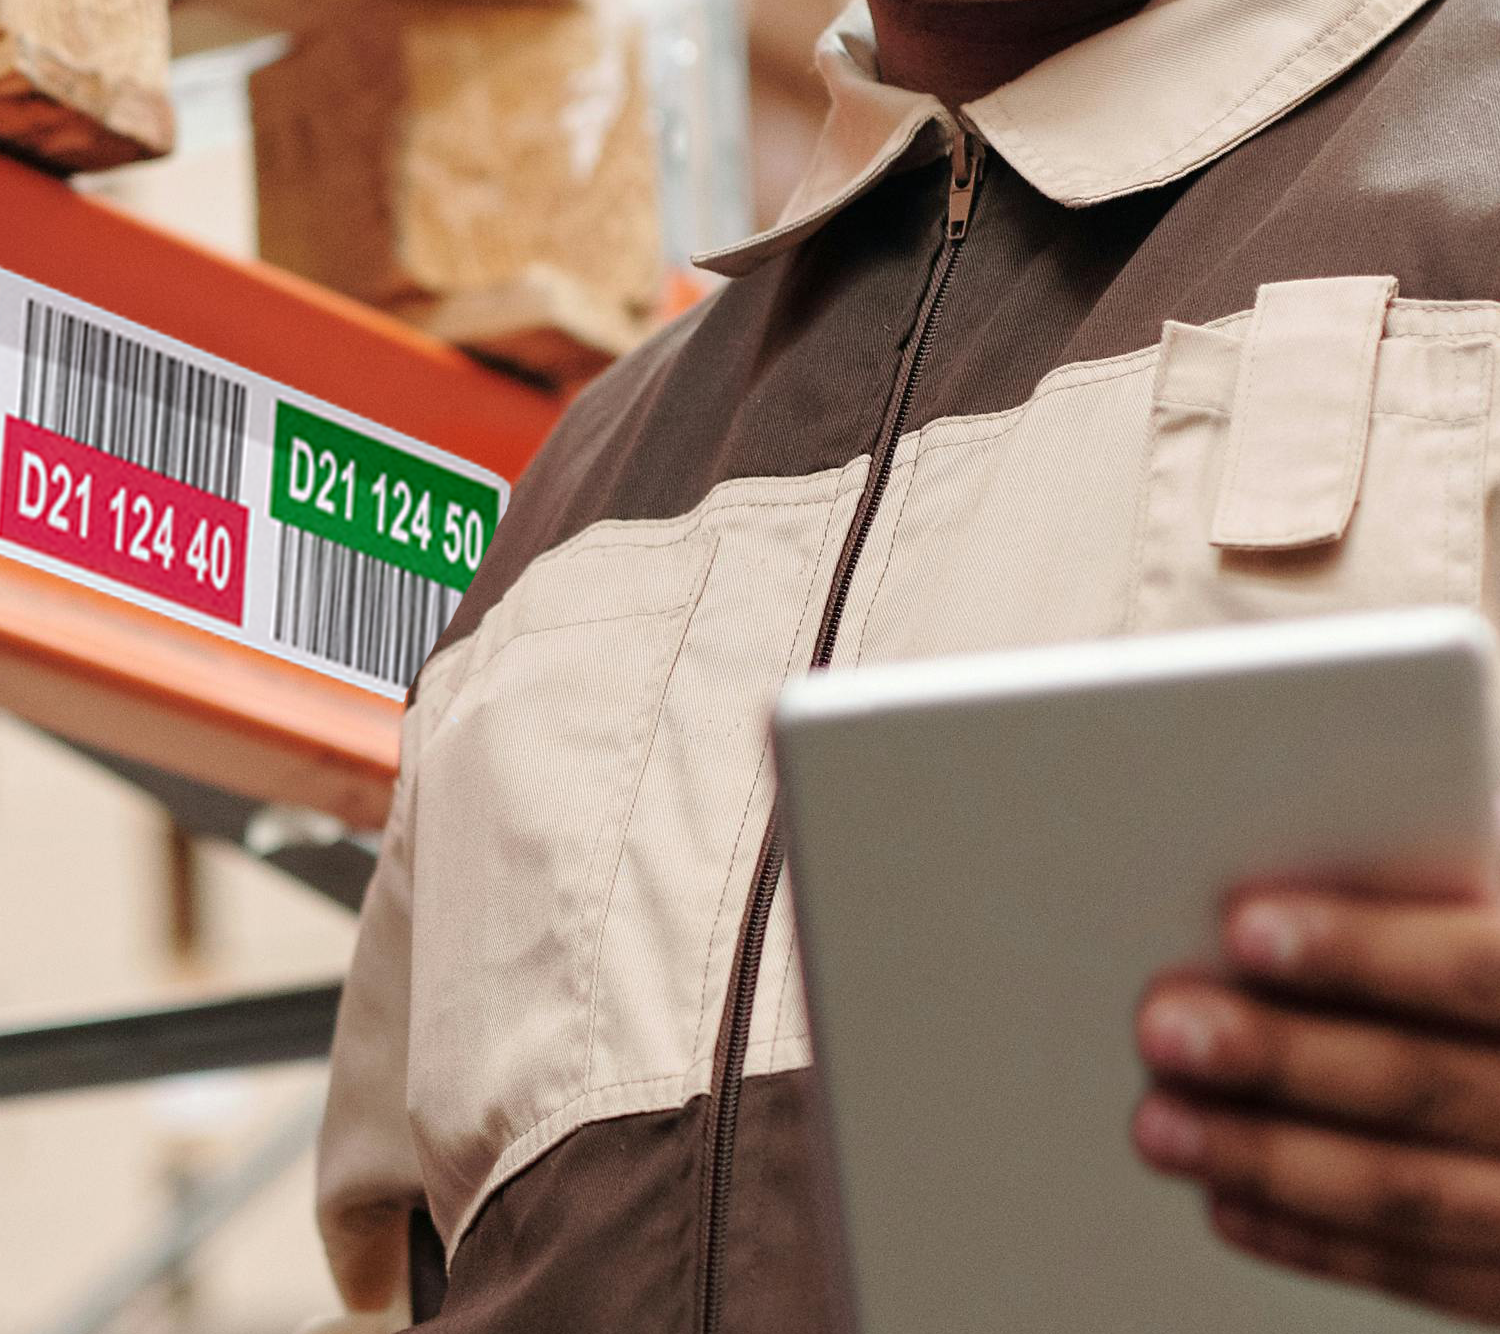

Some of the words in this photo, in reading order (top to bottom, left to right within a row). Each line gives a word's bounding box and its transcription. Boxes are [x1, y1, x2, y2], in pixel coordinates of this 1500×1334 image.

[18, 451, 92, 538] D21
[110, 488, 175, 569] 124
[186, 519, 231, 590] 40
[289, 438, 355, 520] D21
[372, 474, 432, 550] 124
[443, 503, 483, 571] 50
